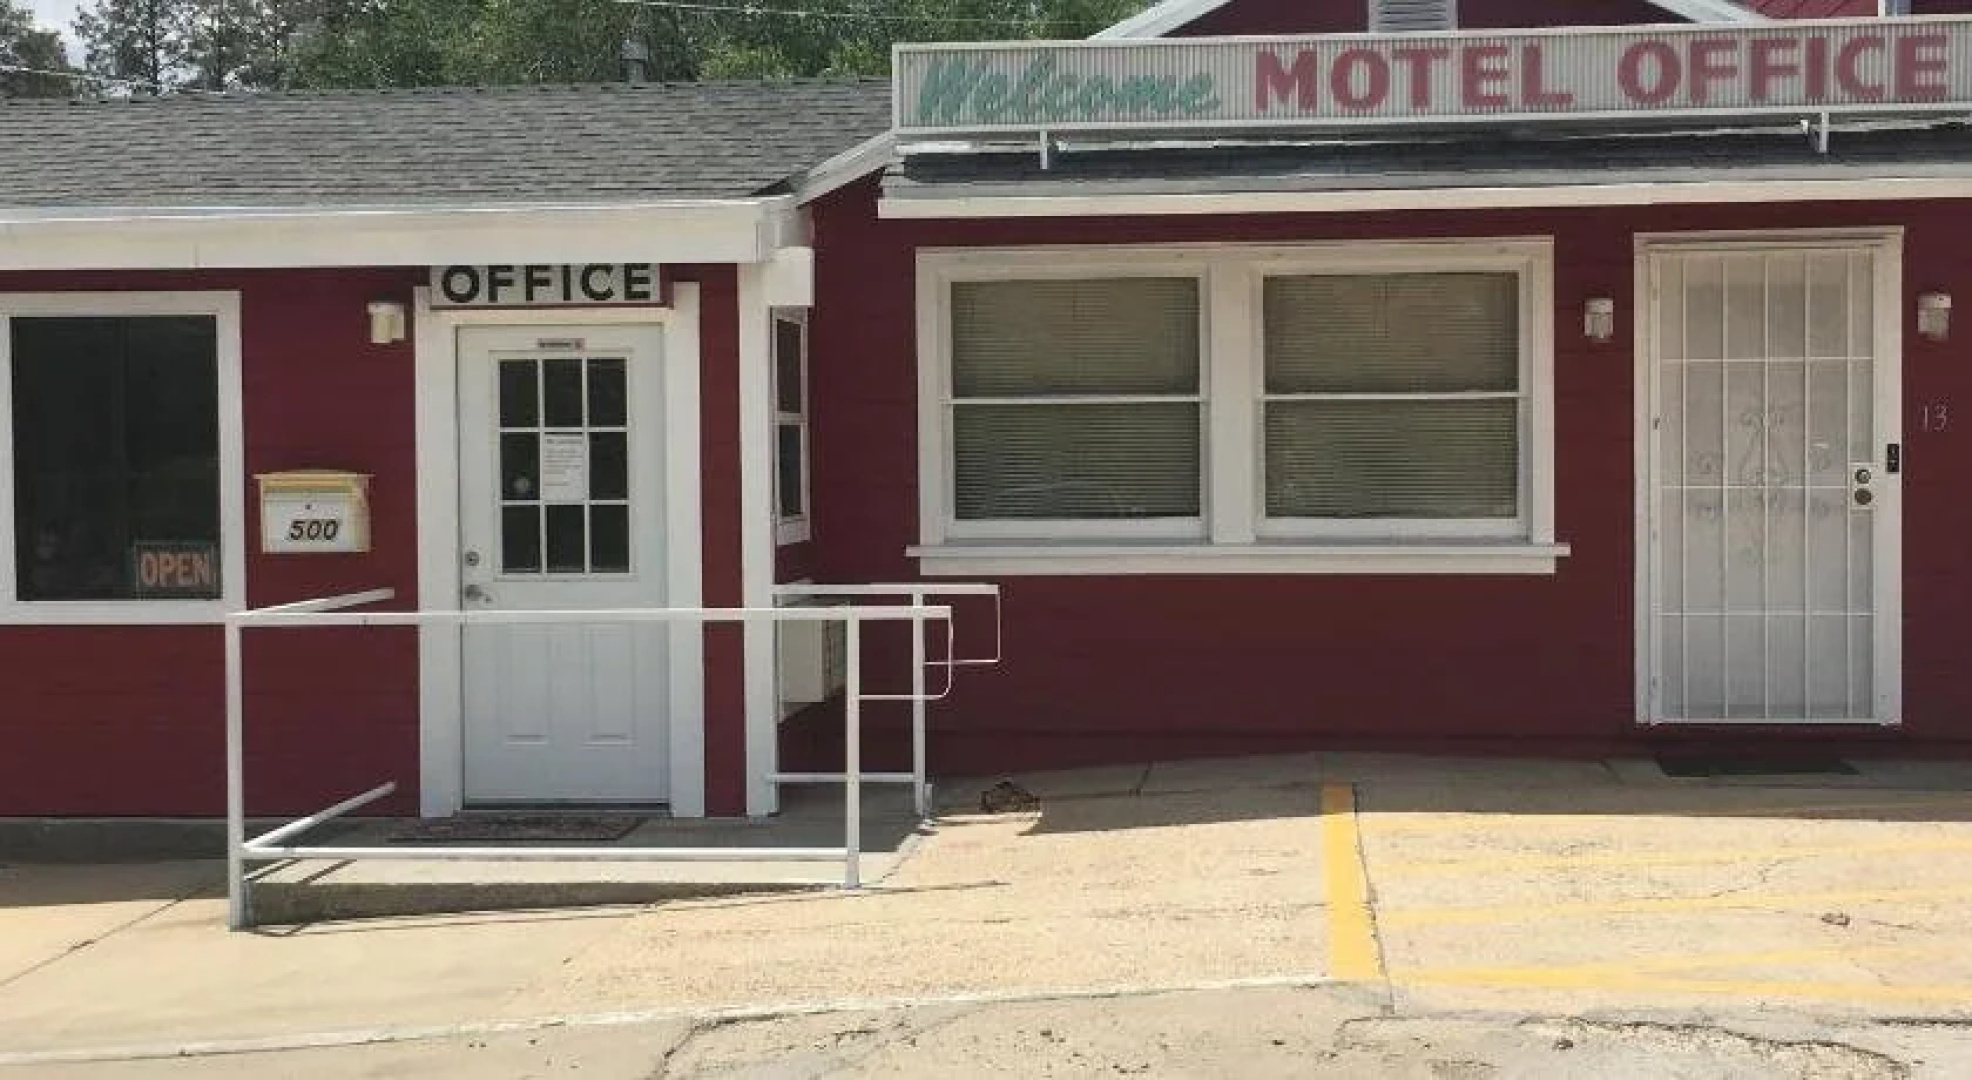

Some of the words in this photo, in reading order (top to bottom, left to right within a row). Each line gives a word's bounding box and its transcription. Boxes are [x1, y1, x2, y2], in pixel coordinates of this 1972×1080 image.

[916, 53, 1221, 119] Welcome
[1255, 46, 1574, 111] MOTEL
[1618, 34, 1949, 104] OFFICE
[442, 264, 652, 303] OFFICE
[1922, 404, 1948, 432] 13
[288, 519, 340, 541] 500
[140, 552, 211, 586] OPEN
